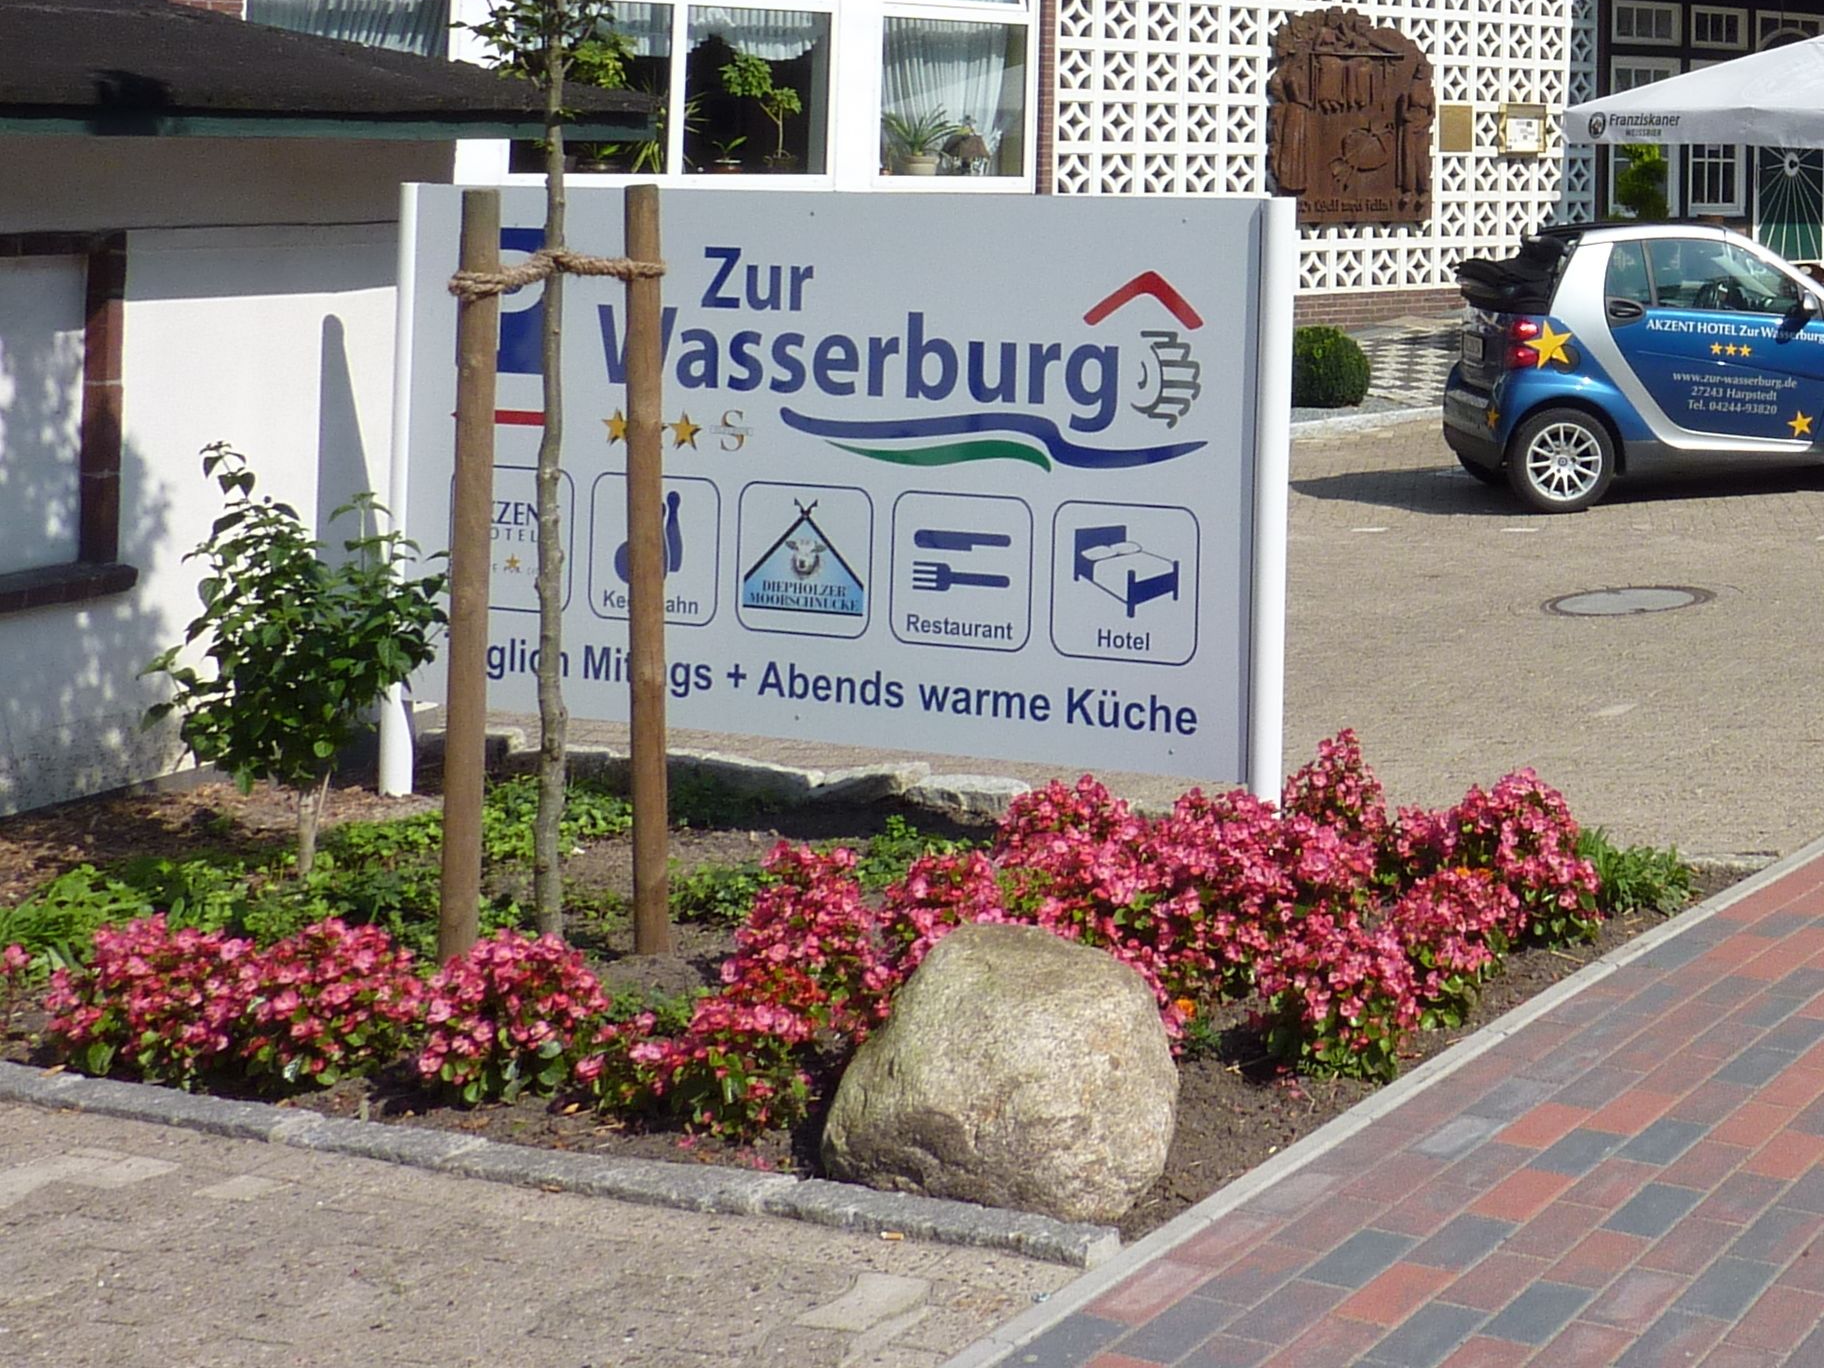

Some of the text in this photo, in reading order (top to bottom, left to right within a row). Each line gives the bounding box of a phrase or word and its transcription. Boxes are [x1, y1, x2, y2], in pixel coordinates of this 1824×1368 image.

[1609, 113, 1681, 127] Franziskaner
[701, 246, 814, 312] Zur
[1646, 319, 1696, 333] AKZENT
[1697, 322, 1737, 336] HOTEL
[1739, 324, 1760, 338] Zur
[597, 304, 1120, 433] Wasserburg
[1672, 372, 1798, 389] www.zur-wasserburg.de
[1691, 385, 1778, 402] 27243 Harpstedt
[1688, 399, 1778, 415] Tel. 04244-93820
[762, 579, 848, 598] DIEPHOLZER
[603, 589, 699, 615] Keahn
[906, 614, 1013, 641] Restaurant
[1096, 628, 1151, 652] Hotel
[758, 660, 904, 709] Abends
[918, 683, 1051, 723] warme
[1066, 686, 1198, 735] Küche
